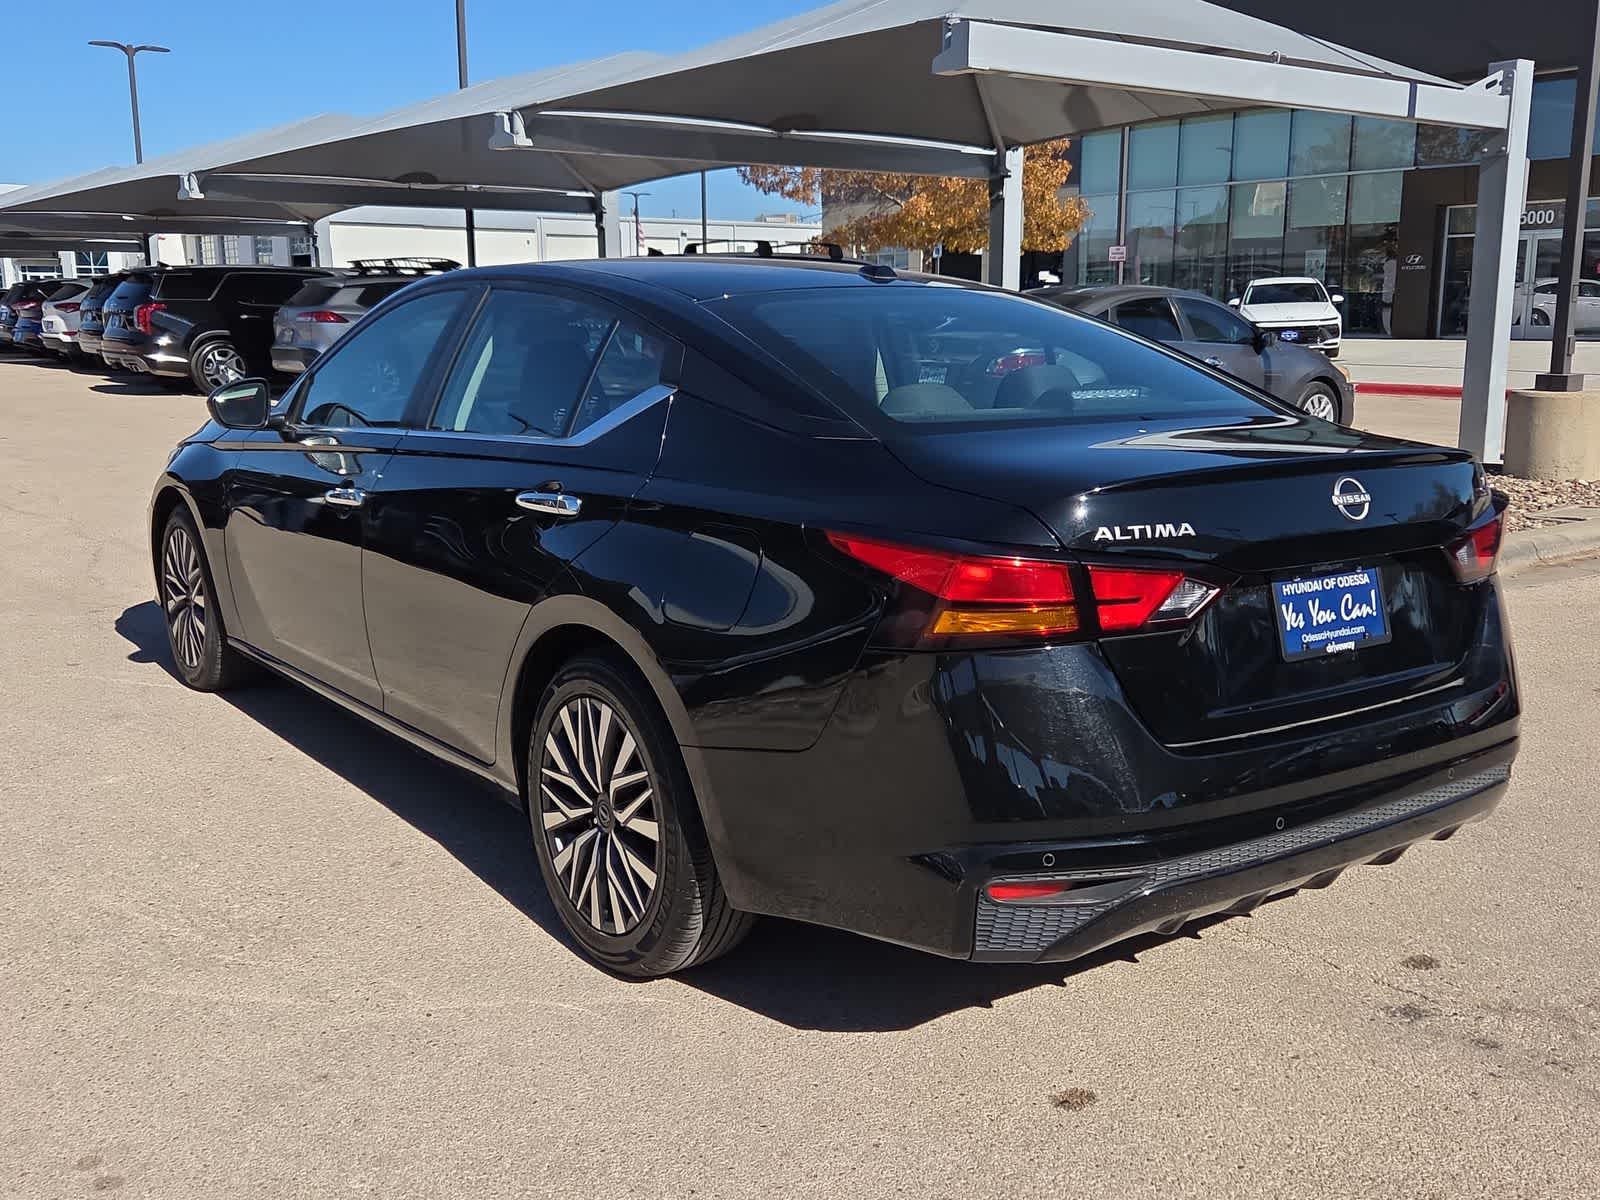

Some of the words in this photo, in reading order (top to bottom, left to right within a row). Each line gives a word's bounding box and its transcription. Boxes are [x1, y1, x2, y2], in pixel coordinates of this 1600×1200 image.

[1333, 494, 1371, 506] NISSAN
[1093, 522, 1196, 542] ALTIMA
[1282, 580, 1322, 595] HYUNDAI
[1323, 578, 1336, 590] OF
[1338, 574, 1370, 588] ODESSA
[1281, 603, 1305, 631] Yes
[1308, 598, 1336, 626] You
[1341, 589, 1377, 621] Can!
[1302, 626, 1365, 642] OdessaHyundai.com
[1326, 641, 1355, 653] driveway
